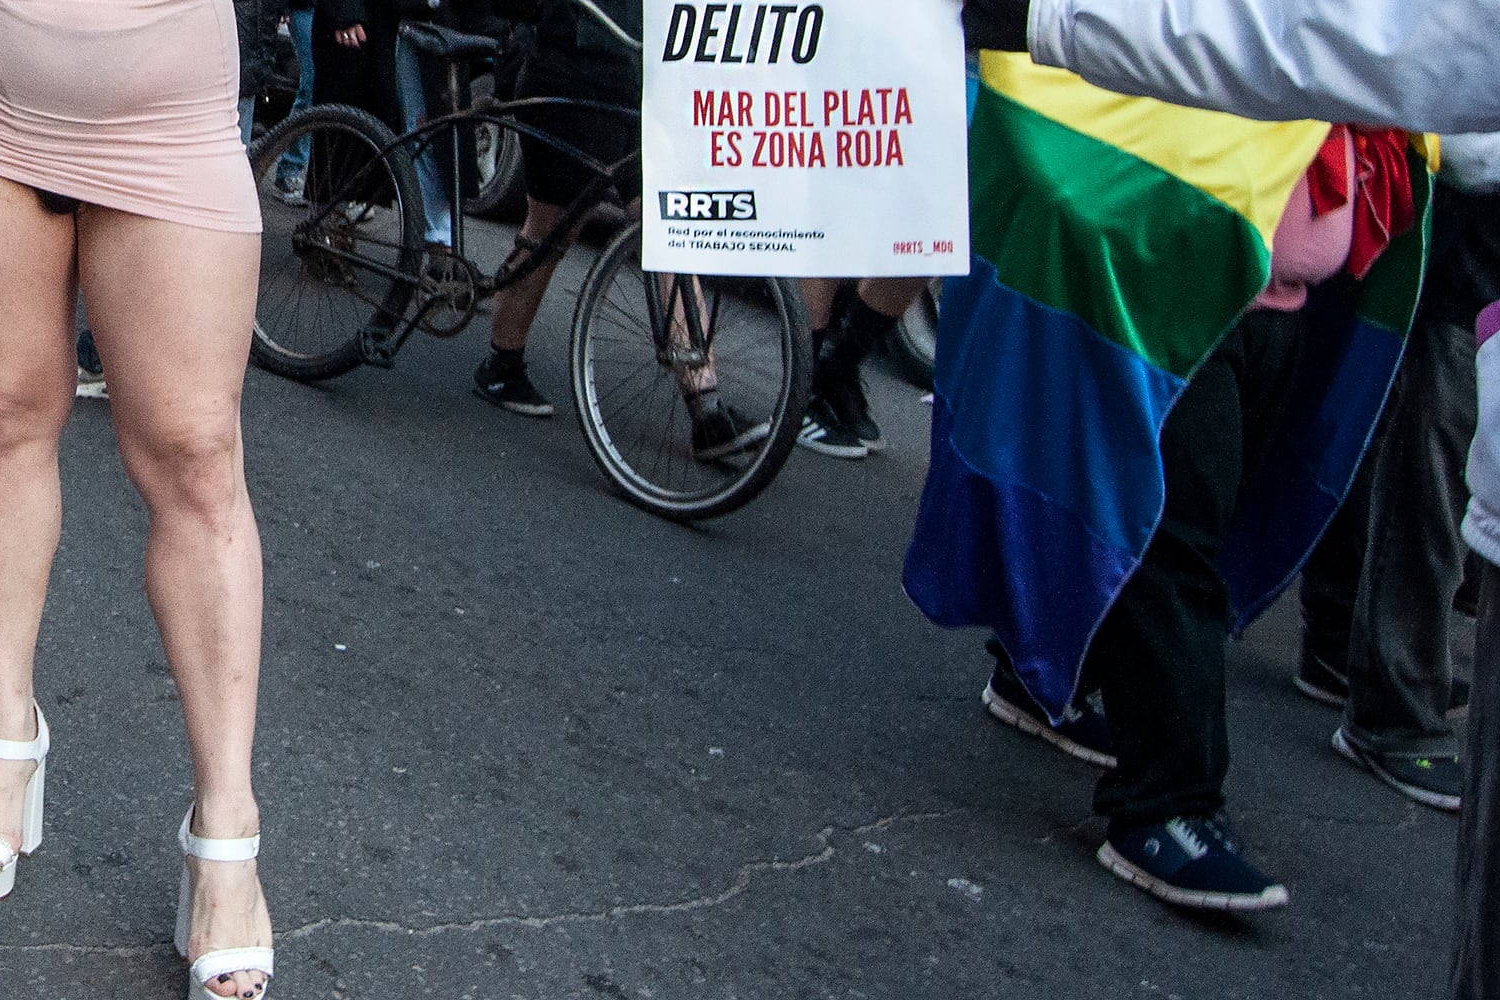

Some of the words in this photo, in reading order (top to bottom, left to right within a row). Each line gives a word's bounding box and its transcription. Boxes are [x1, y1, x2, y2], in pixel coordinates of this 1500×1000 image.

[662, 4, 824, 64] DELITO
[693, 89, 753, 127] MAR
[765, 90, 814, 127] DEL
[824, 87, 913, 126] PLATA
[711, 131, 742, 167] ES
[752, 131, 826, 168] ZONA
[837, 129, 904, 167] ROJA
[667, 192, 755, 219] RRTS
[668, 226, 690, 236] Red
[693, 228, 713, 239] por
[717, 227, 727, 237] el
[731, 228, 825, 239] reconocimiento
[689, 240, 746, 251] TRABAJO
[749, 241, 796, 252] SEXUAL
